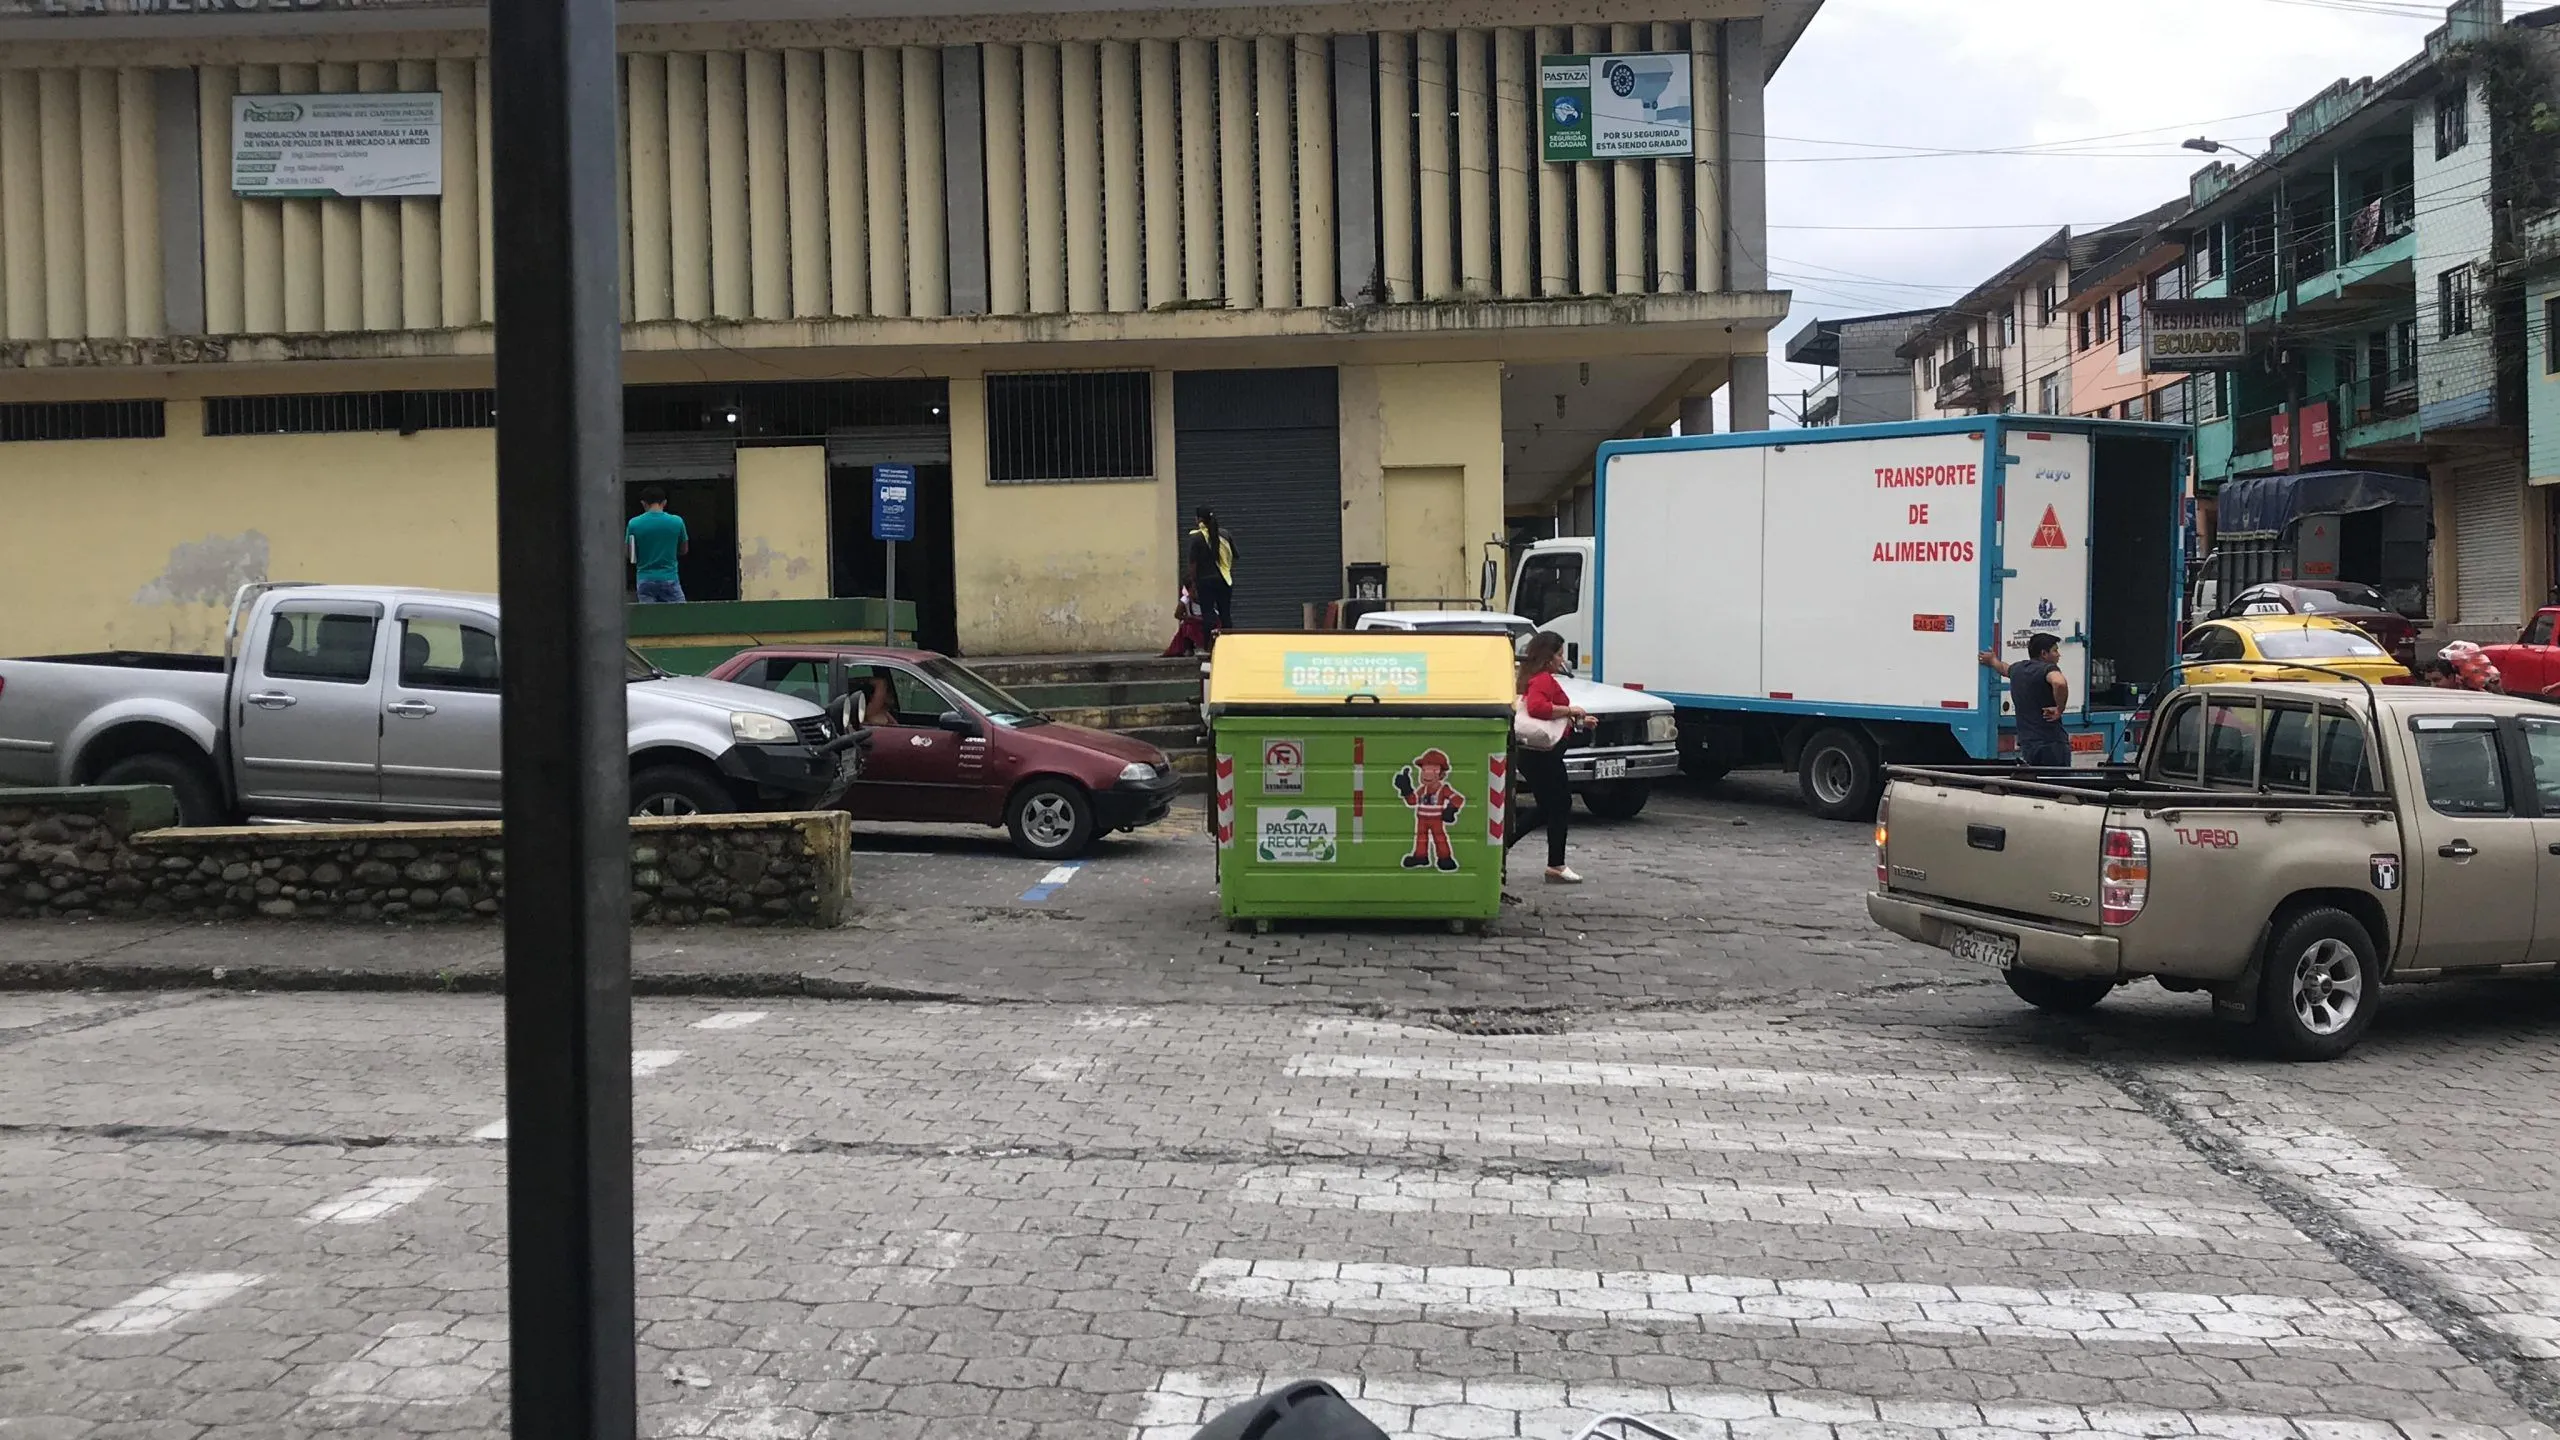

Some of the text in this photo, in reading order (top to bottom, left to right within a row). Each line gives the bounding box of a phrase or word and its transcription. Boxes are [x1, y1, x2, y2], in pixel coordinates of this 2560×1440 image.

[1544, 72, 1587, 81] PASTAZA
[1549, 134, 1587, 142] SEGURIDAD
[1603, 129, 1680, 140] POR SU SEGURIDAD
[293, 139, 322, 147] POLLOS
[324, 139, 334, 147] EN
[345, 138, 385, 146] MERCADO
[399, 137, 430, 145] MERCED
[1549, 141, 1588, 149] CIUDADANA
[1596, 139, 1688, 150] ESTA SIENDO GRABADO
[2152, 310, 2242, 331] RESIDENCIAL
[2153, 331, 2241, 355] ECUADOR
[1874, 464, 1976, 488] TRANSPORTE
[2035, 466, 2072, 482] Puyo
[1908, 503, 1929, 525] DE
[1872, 541, 1974, 562] ALIMENTOS
[2255, 603, 2279, 613] TAXI
[2030, 619, 2061, 629] Hunter
[1312, 657, 1399, 666] DESECHOS
[1266, 822, 1328, 835] PASTAZA
[2174, 828, 2239, 848] TURBO
[1892, 865, 1927, 881] mazda
